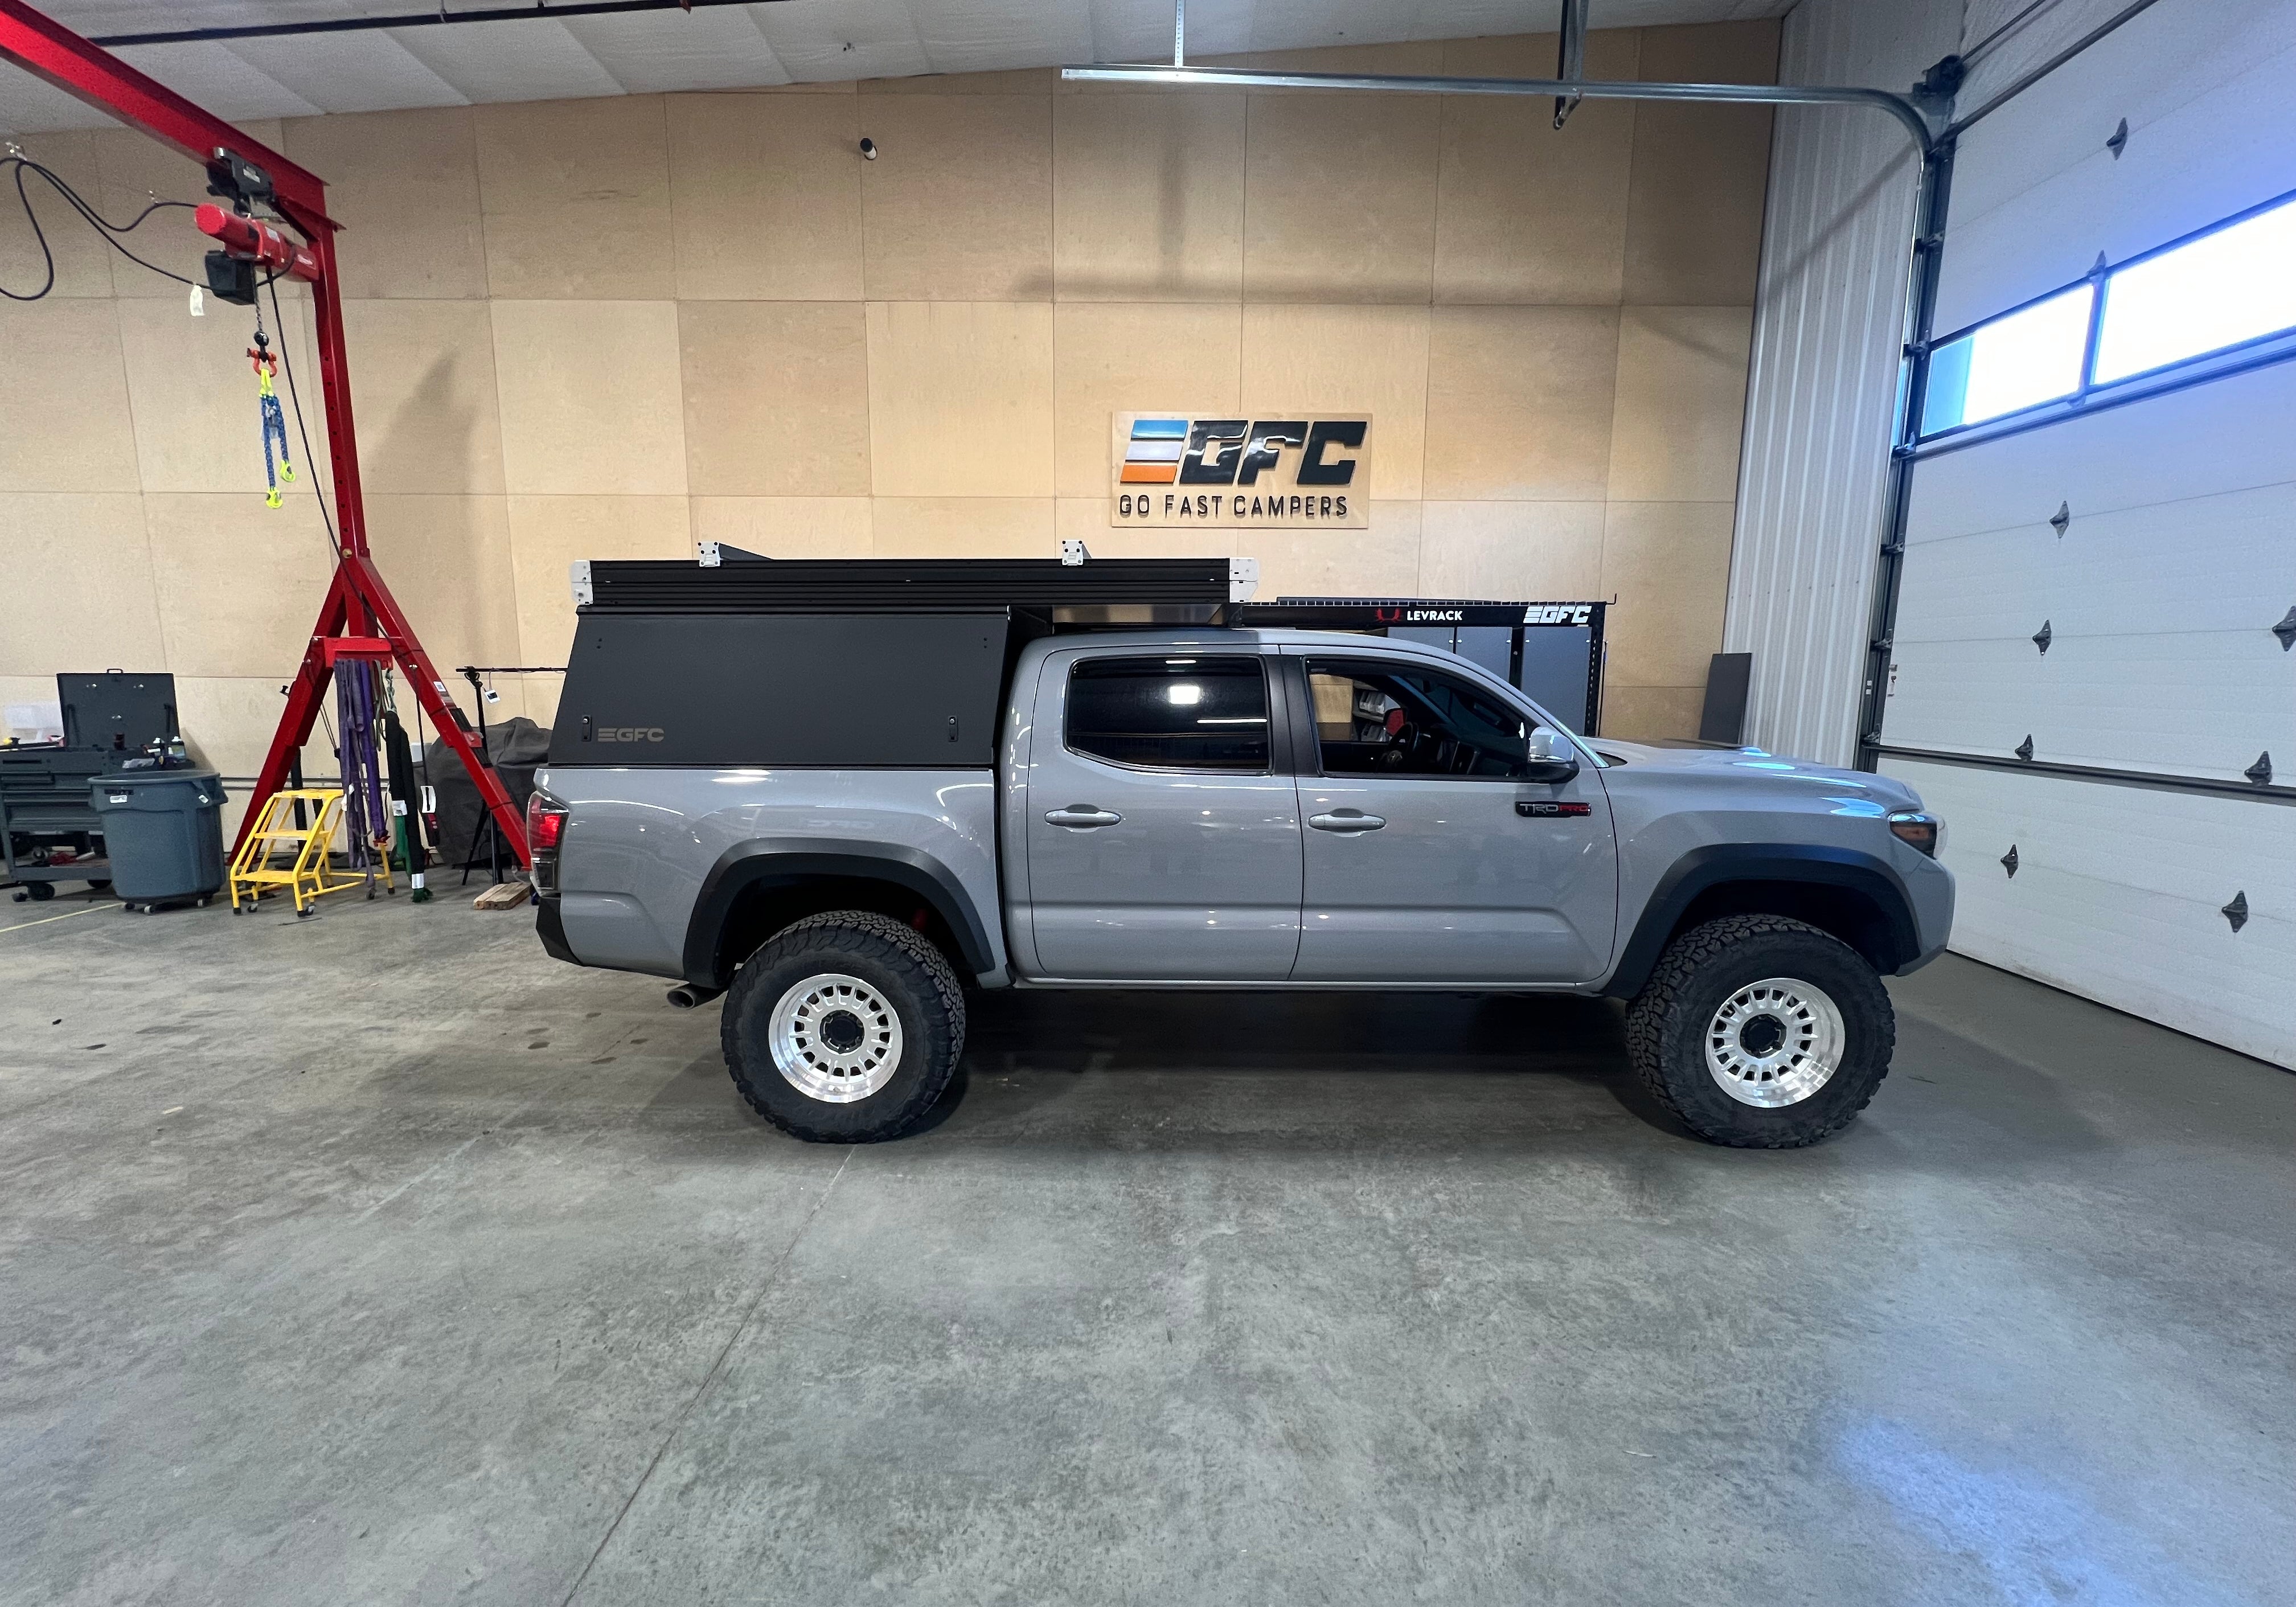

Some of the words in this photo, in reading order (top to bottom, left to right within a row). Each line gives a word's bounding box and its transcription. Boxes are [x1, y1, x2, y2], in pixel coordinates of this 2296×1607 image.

[1179, 420, 1367, 485] GFC
[1120, 494, 1150, 516] GO
[1165, 494, 1223, 516] FAST
[1233, 495, 1348, 516] CAMPERS
[1407, 610, 1463, 621] LEVRACK
[1539, 605, 1592, 624] GFC
